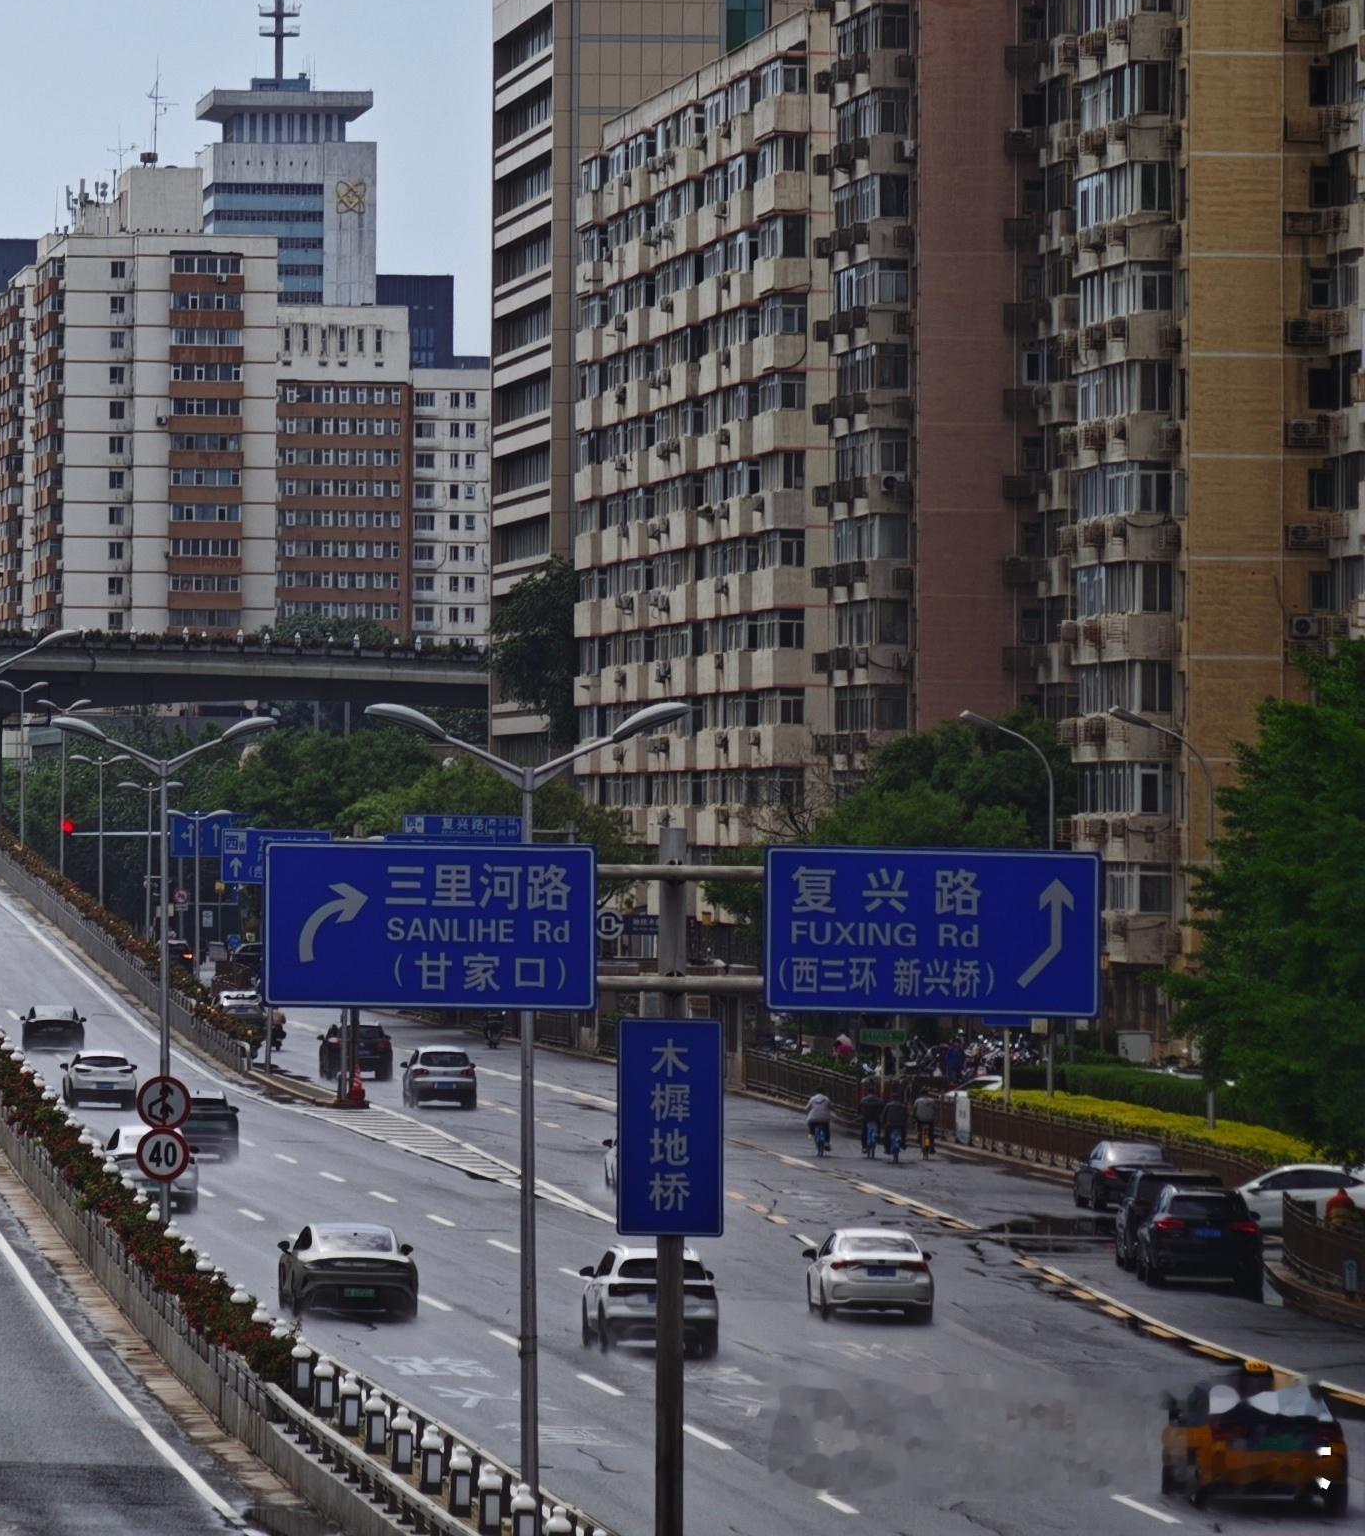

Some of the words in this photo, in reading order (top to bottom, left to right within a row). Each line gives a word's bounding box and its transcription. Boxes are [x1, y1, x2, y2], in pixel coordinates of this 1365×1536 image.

[384, 864, 571, 911] 三里河路
[790, 866, 982, 916] 复兴路
[386, 916, 514, 943] SANLIHE
[532, 919, 570, 943] Rd
[790, 921, 917, 947] FUXING
[938, 923, 980, 948] Rd
[648, 1038, 691, 1212] 木樨地桥
[148, 1140, 178, 1168] 40
